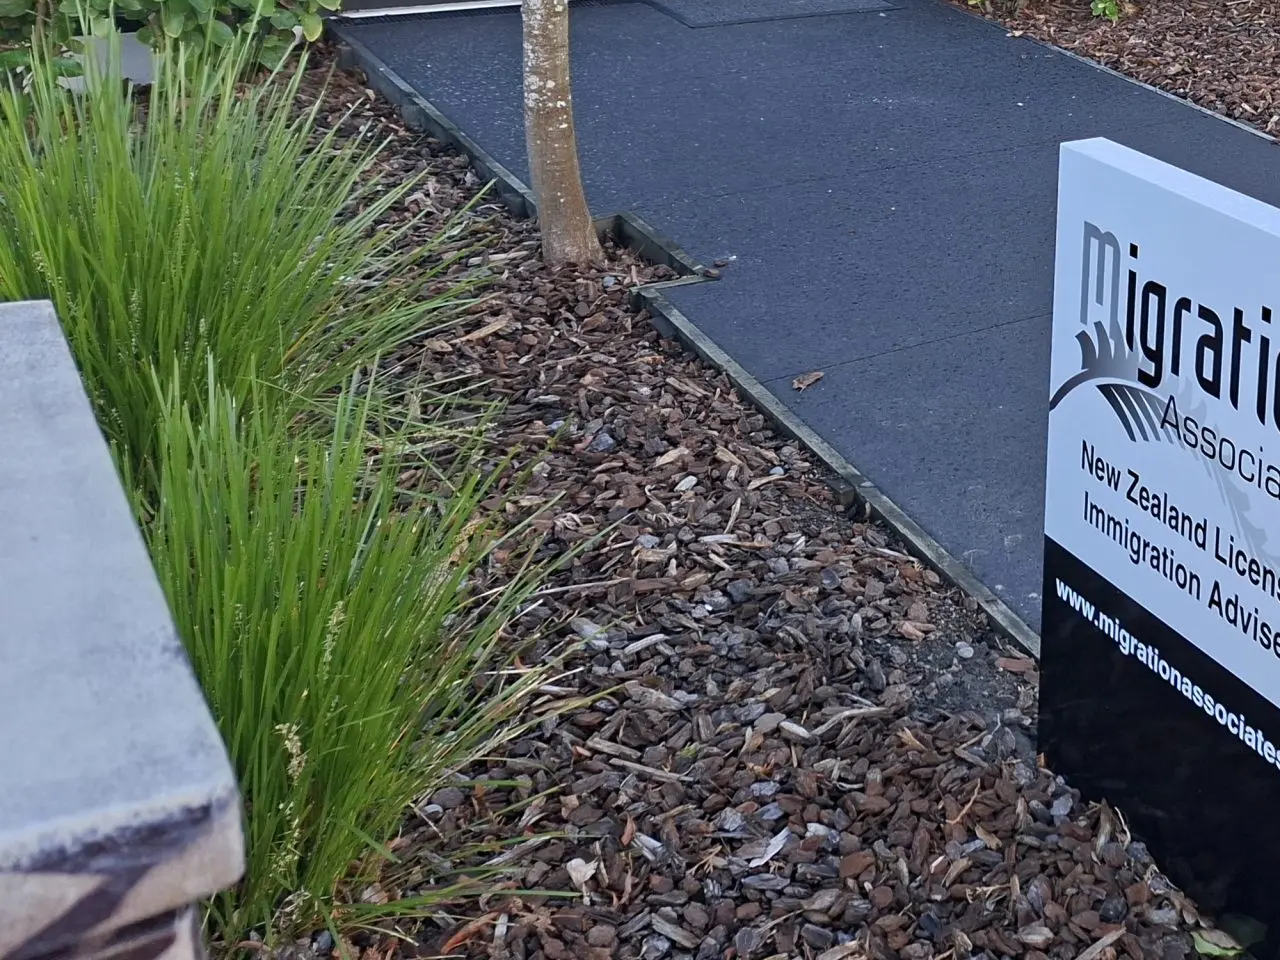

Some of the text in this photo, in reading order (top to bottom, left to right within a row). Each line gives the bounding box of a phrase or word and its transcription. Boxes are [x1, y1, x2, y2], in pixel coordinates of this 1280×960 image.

[1081, 440, 1121, 493] New
[1126, 468, 1208, 551] Zealand
[1083, 491, 1201, 601] Immigration
